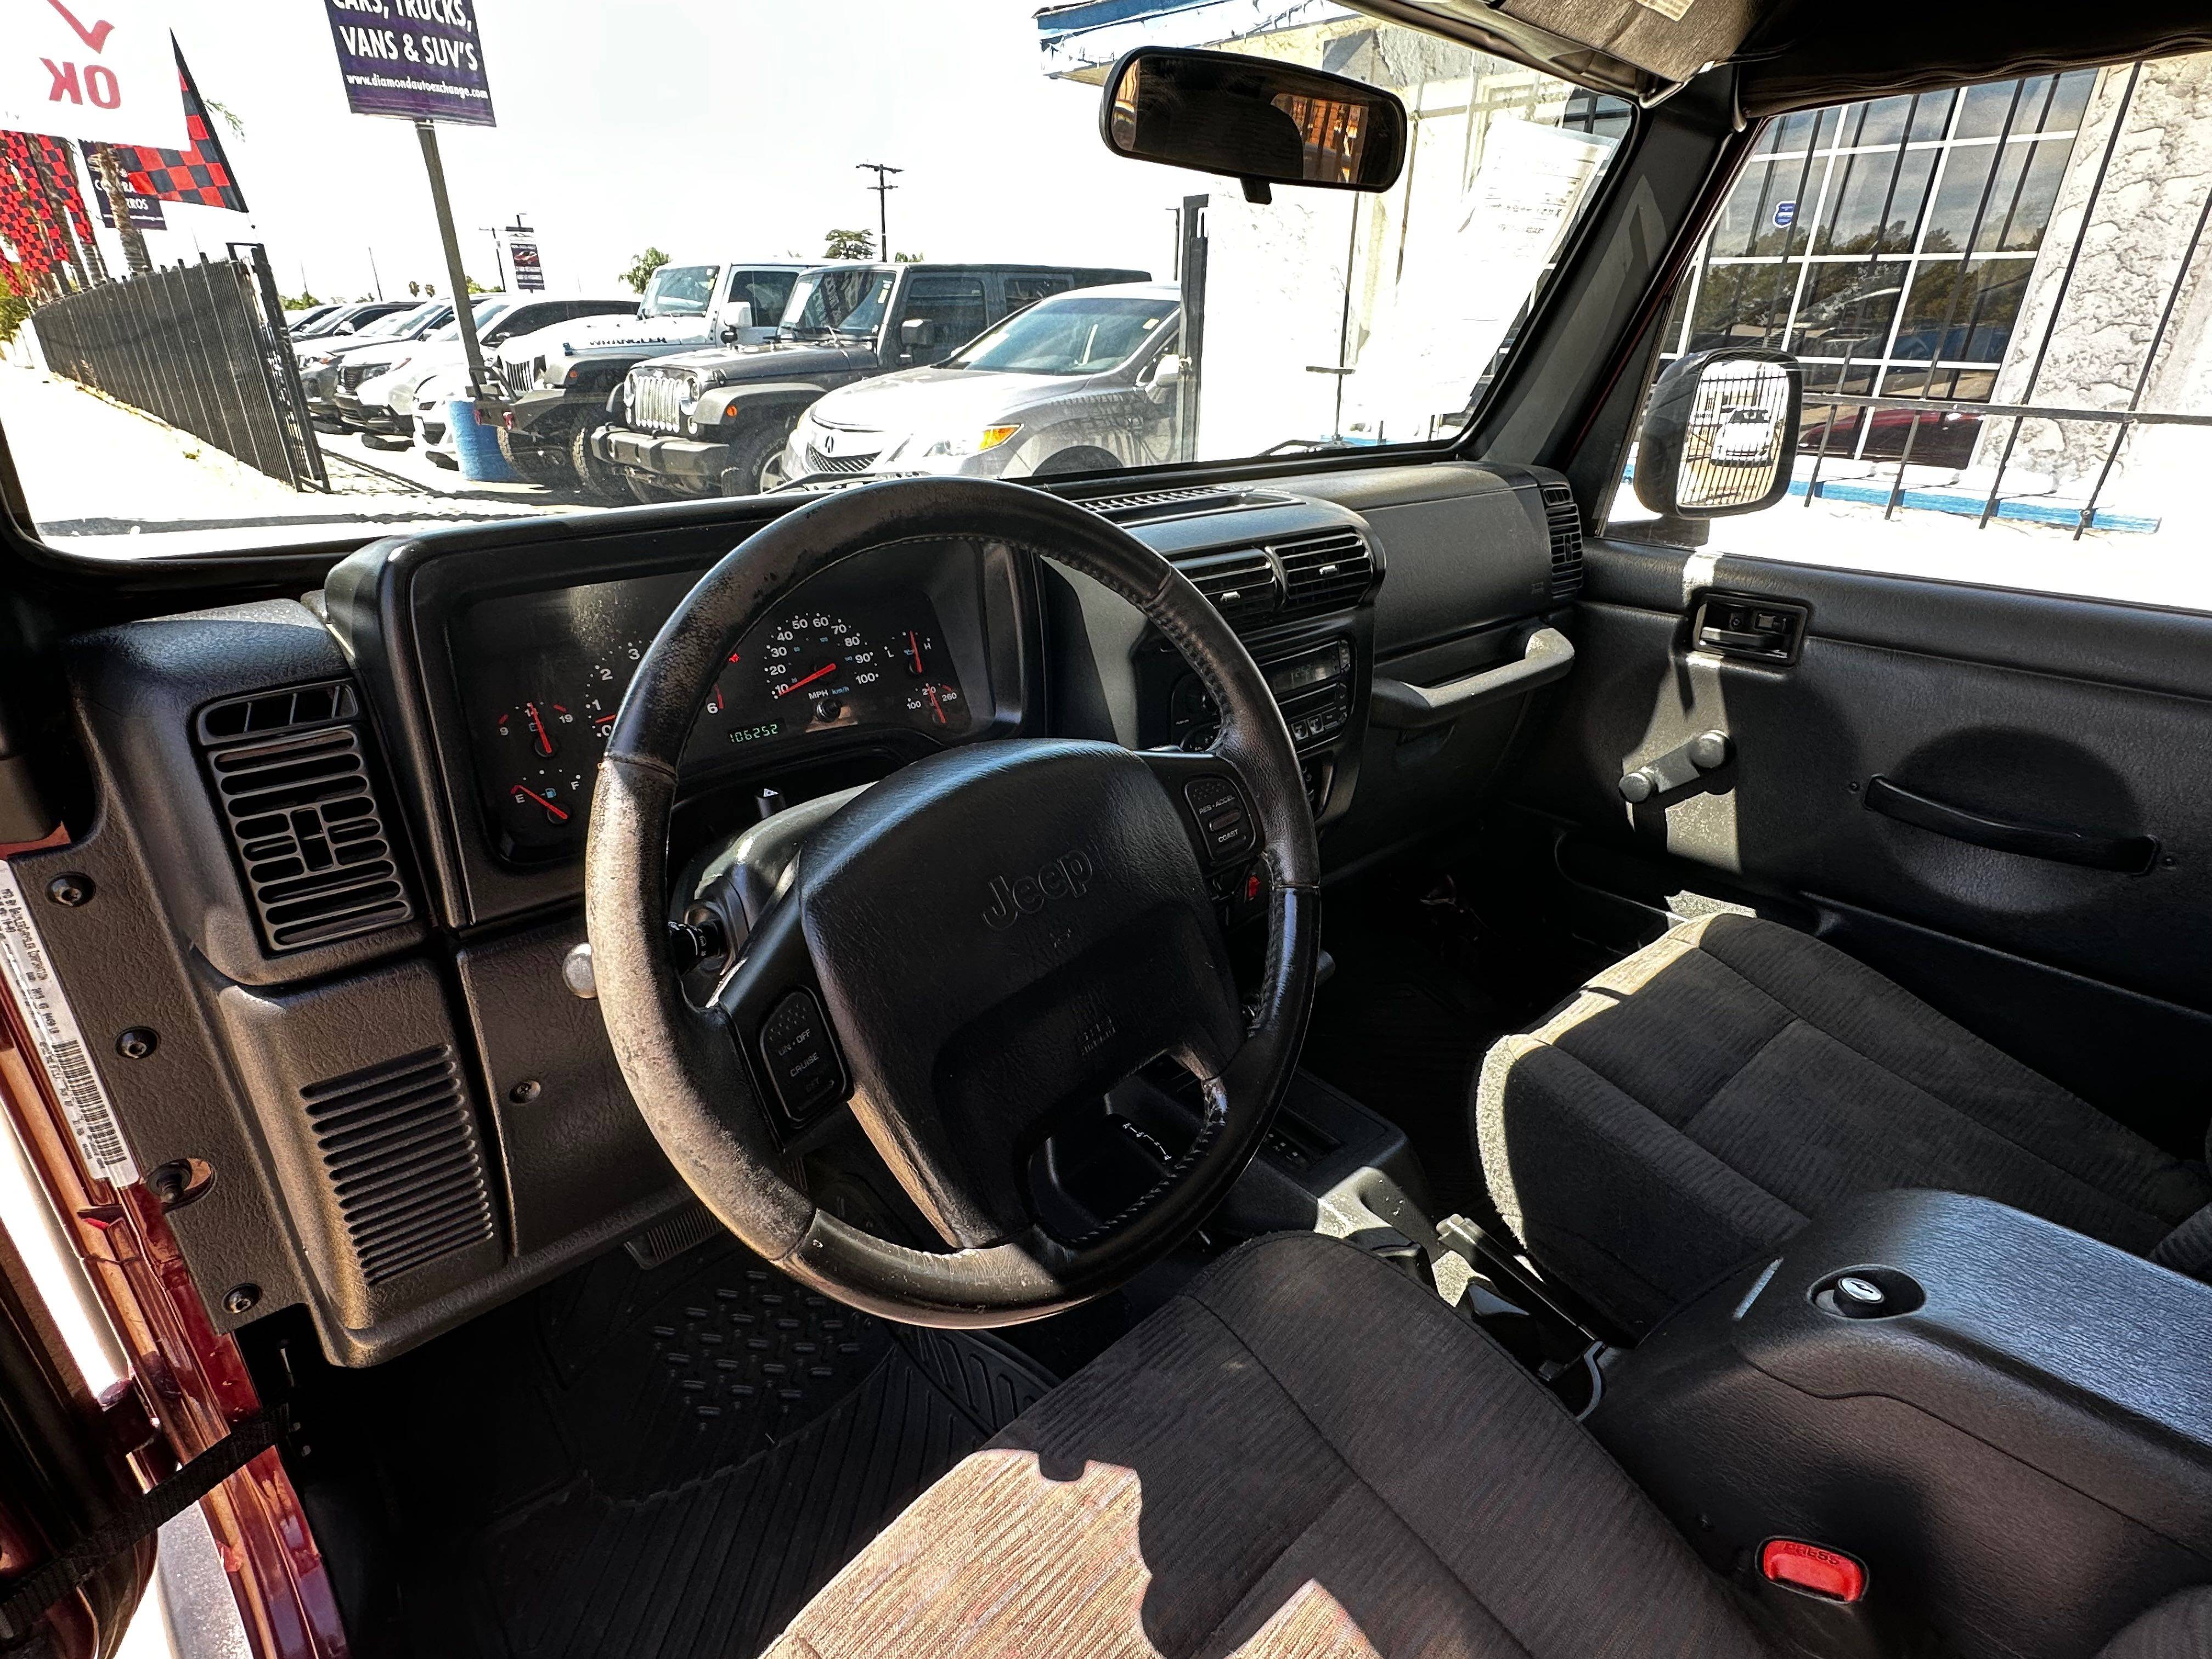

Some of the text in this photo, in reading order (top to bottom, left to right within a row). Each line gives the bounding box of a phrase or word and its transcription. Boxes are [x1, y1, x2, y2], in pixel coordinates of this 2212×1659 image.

[338, 25, 478, 71] VANS & SUV'S
[346, 72, 488, 99] www.diamondautoexchange.com
[792, 619, 809, 630] 50
[812, 617, 829, 628] 60
[831, 624, 847, 635] 70
[777, 631, 793, 641] 40
[844, 636, 860, 647] 80
[628, 648, 641, 660] 3
[770, 646, 788, 658] 30
[887, 650, 895, 658] L
[855, 653, 871, 664] 90
[600, 668, 613, 681] 2
[769, 664, 786, 676] 20
[855, 673, 876, 685] 100
[775, 684, 788, 695] 10
[808, 689, 828, 700] MPH
[922, 686, 936, 696] 20
[941, 692, 957, 702] 260
[591, 699, 601, 710] 1
[707, 703, 718, 714] 6
[906, 701, 922, 710] 100
[558, 714, 574, 724] 19
[730, 723, 778, 743] 106252
[571, 780, 579, 790] F
[515, 793, 526, 803] E
[1218, 828, 1238, 843] COAST
[980, 850, 1092, 930] Jeep
[795, 1028, 811, 1043] OFF
[790, 1052, 819, 1077] CRUISE
[1784, 1542, 1840, 1565] PRESS
